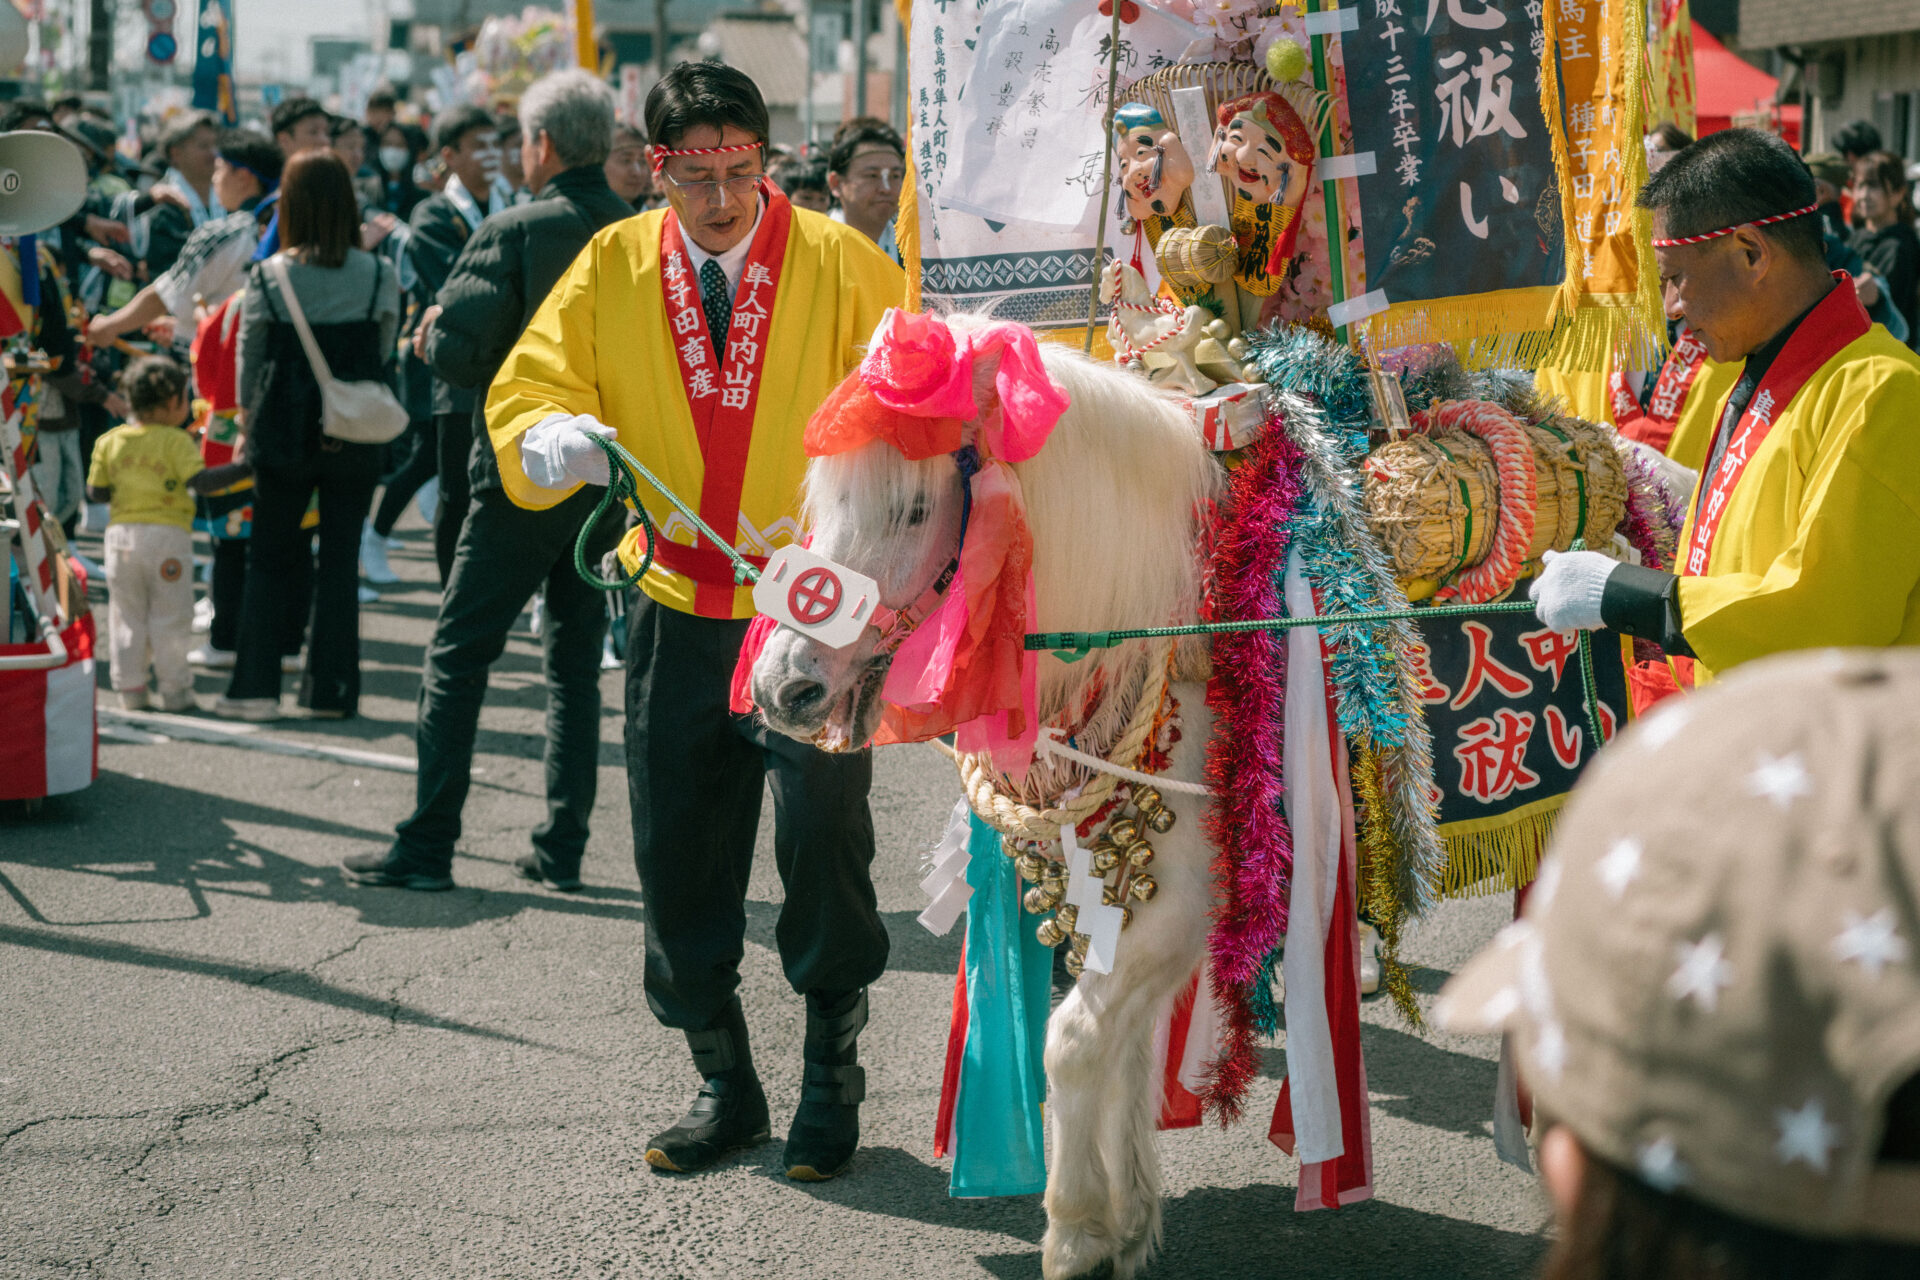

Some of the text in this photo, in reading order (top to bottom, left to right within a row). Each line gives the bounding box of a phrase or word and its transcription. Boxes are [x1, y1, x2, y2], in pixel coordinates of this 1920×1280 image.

[933, 25, 948, 188] 霧島市隼人町内
[663, 250, 719, 400] 種子田畜産
[721, 261, 774, 411] 隼人町内山田
[1652, 333, 1707, 420] 町内山田
[1689, 388, 1776, 576] 隼人町内山田
[1428, 698, 1617, 804] 祓い
